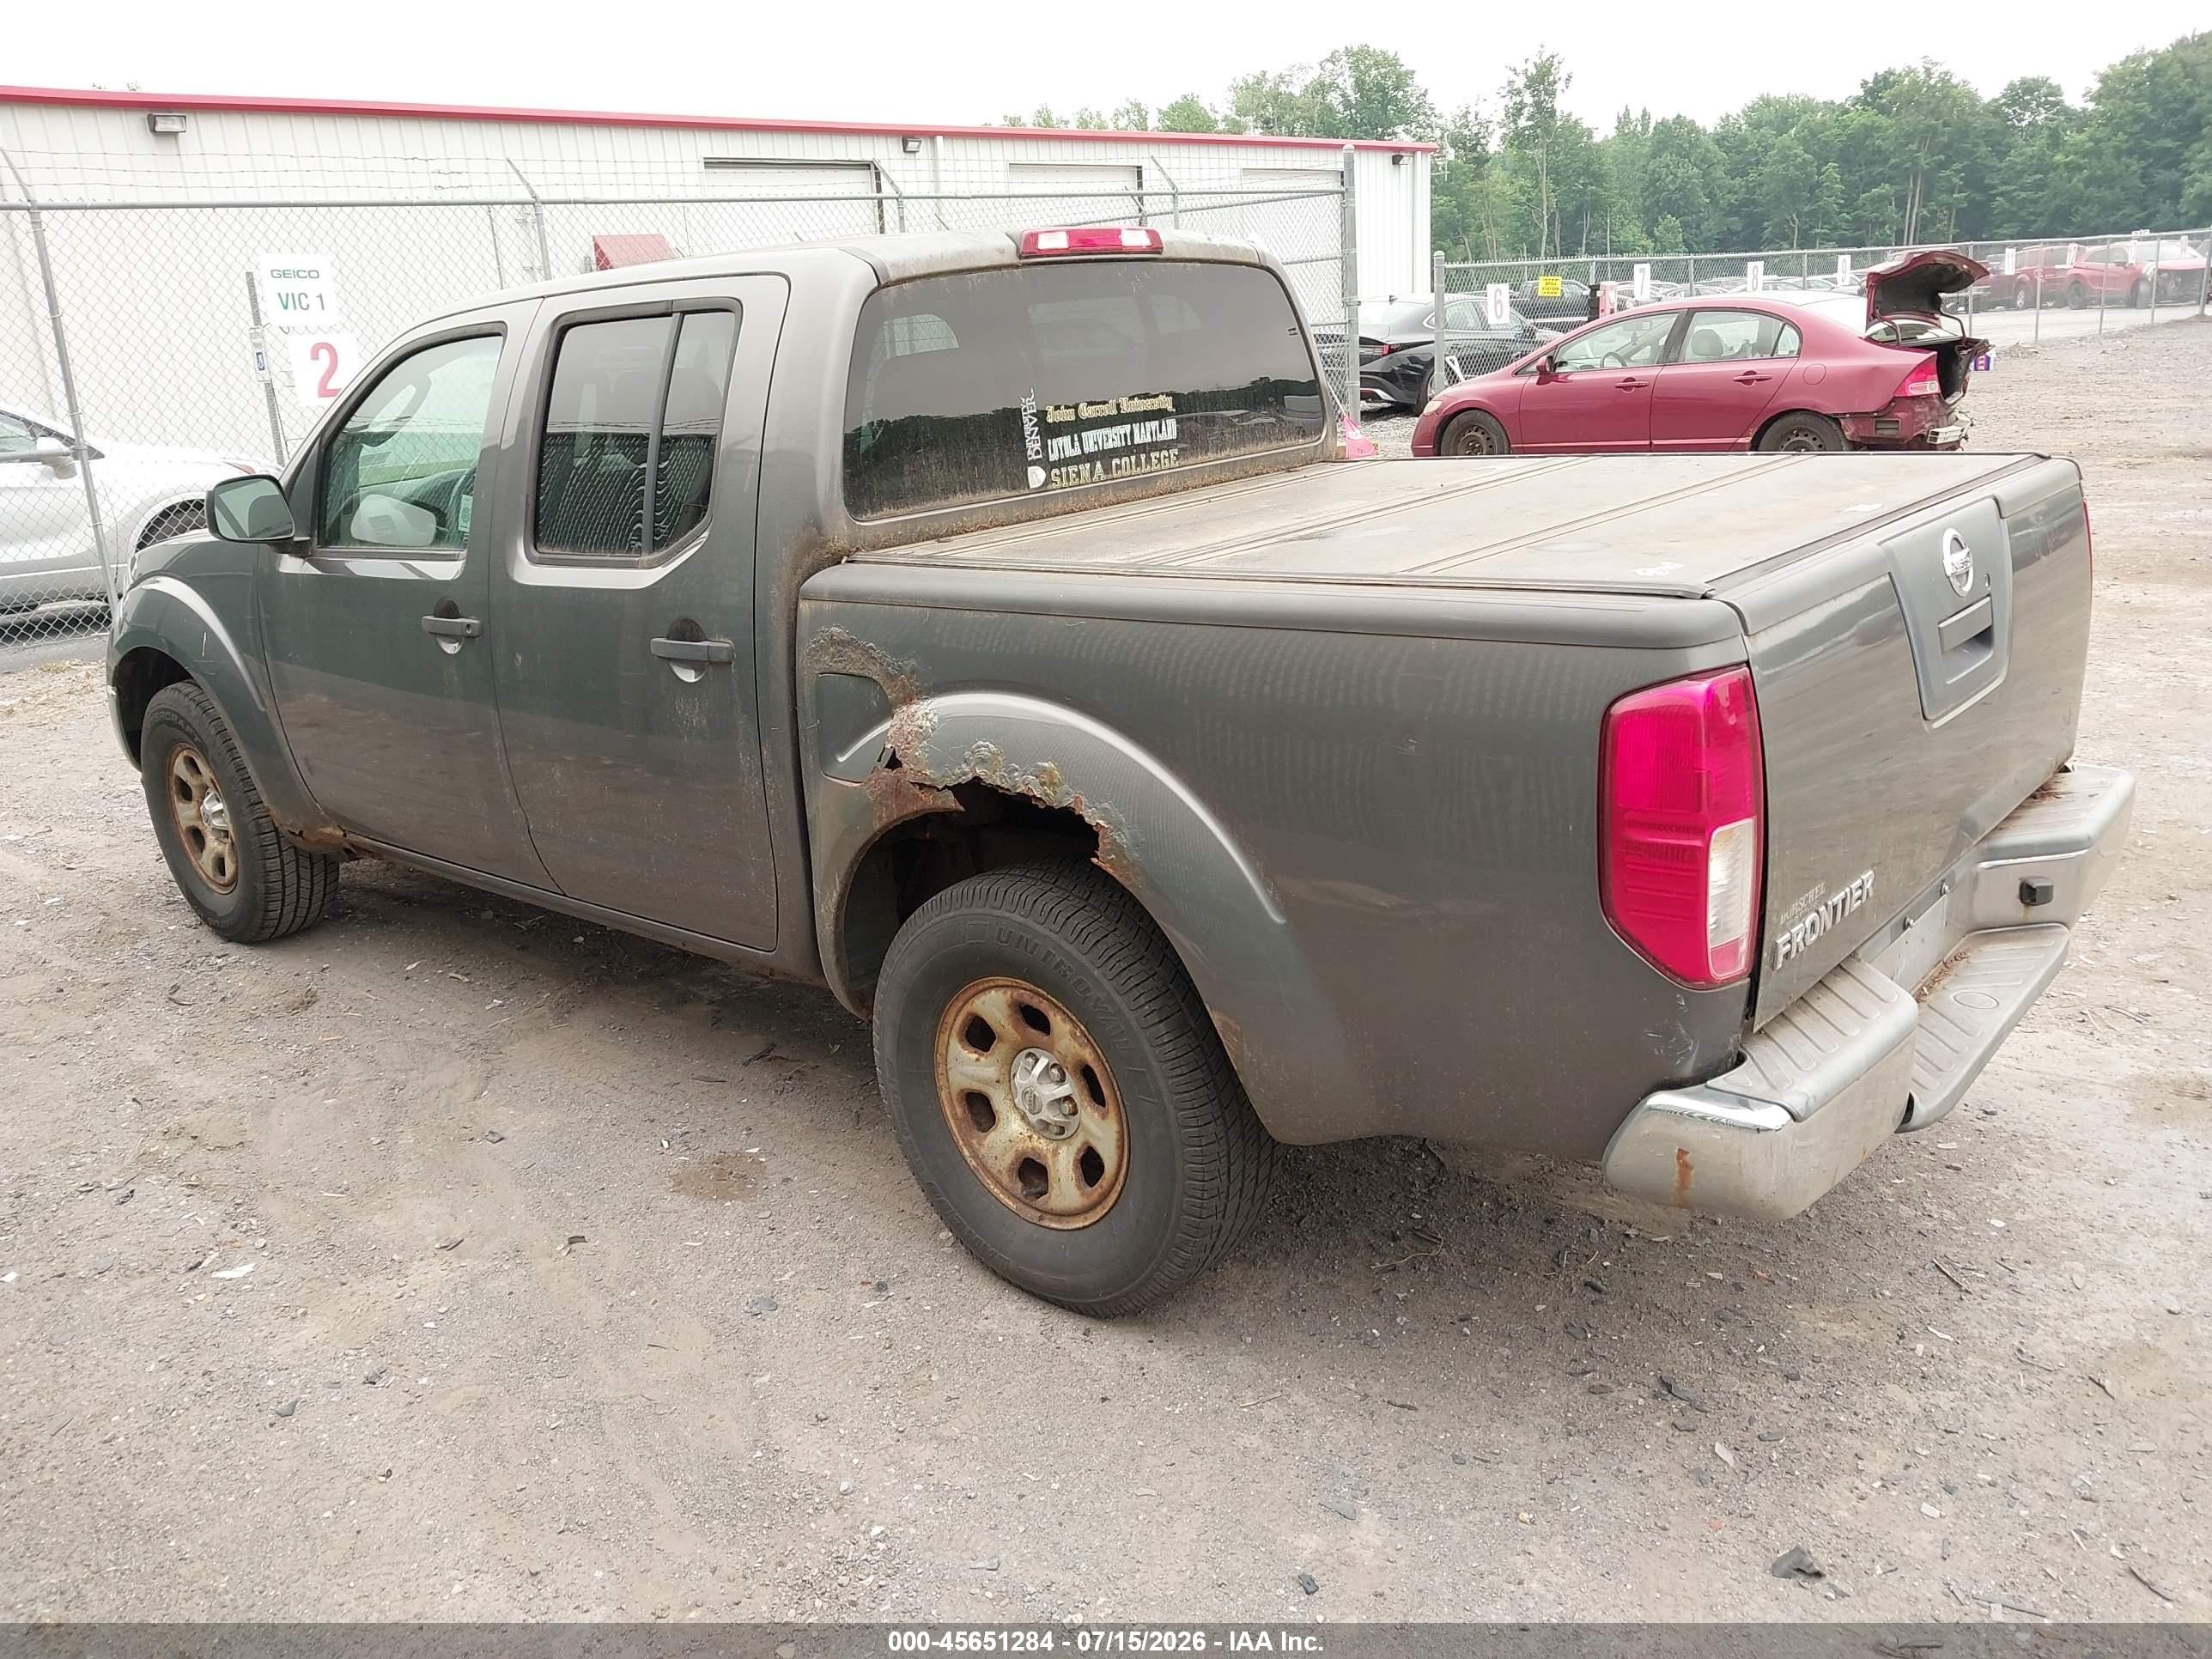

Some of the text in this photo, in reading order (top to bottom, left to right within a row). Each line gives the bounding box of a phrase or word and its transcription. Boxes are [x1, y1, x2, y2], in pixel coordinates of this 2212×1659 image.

[270, 269, 320, 279] GEICO
[1638, 268, 1646, 296] 7
[1752, 264, 1759, 291] 8
[277, 292, 325, 311] VIC 1
[1493, 288, 1504, 320] 6
[310, 342, 343, 398] 2
[1026, 392, 1042, 459] DENVER
[1044, 404, 1076, 423] John
[1078, 399, 1117, 419] Carroll
[1047, 418, 1178, 462] LOYOLA UNIVERSITY MARYLAND
[1050, 448, 1179, 489] SIENA COLLEGE
[1773, 869, 1875, 971] FRONTIER
[996, 927, 1136, 1051] UNIROYAL
